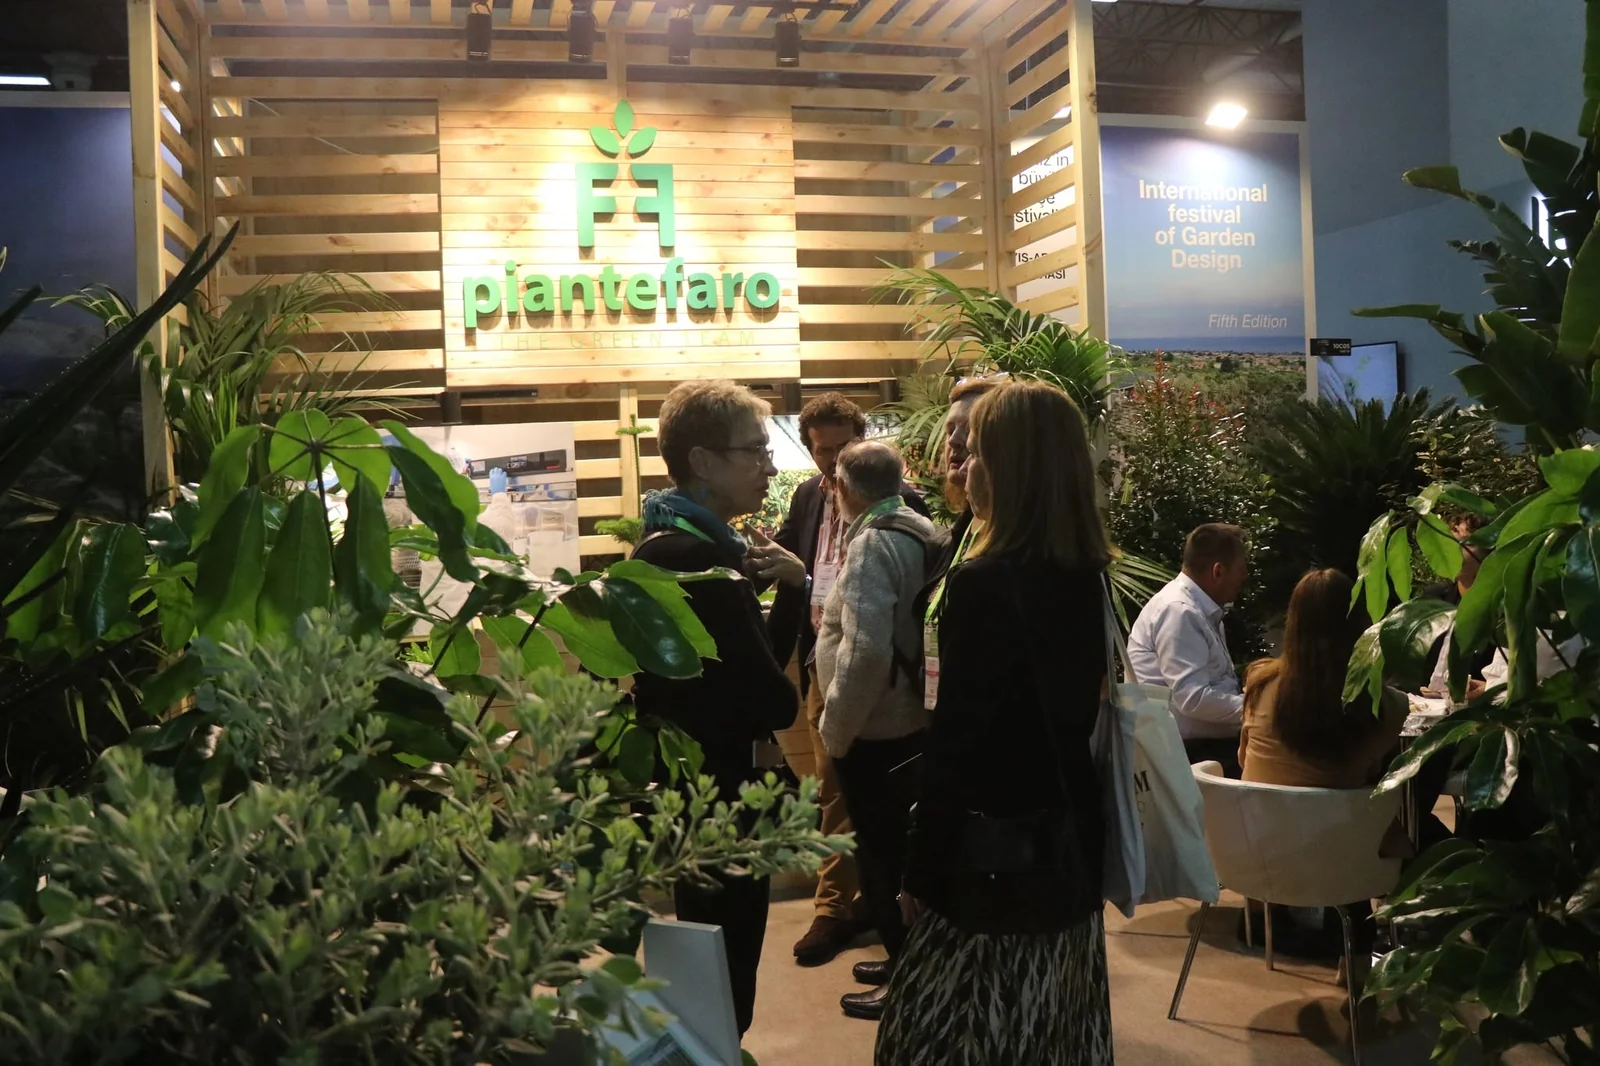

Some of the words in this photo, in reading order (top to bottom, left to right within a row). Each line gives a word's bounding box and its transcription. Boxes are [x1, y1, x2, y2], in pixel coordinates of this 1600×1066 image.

[1139, 179, 1268, 202] International
[1168, 203, 1242, 224] festival
[1155, 226, 1176, 245] of
[1181, 226, 1256, 246] Garden
[1171, 248, 1243, 273] Design
[463, 257, 780, 328] piantefaro
[1208, 314, 1238, 328] Fifth
[1242, 314, 1288, 328] Edition
[500, 335, 549, 350] THE
[571, 332, 662, 349] GREEN
[683, 331, 755, 347] TEAM
